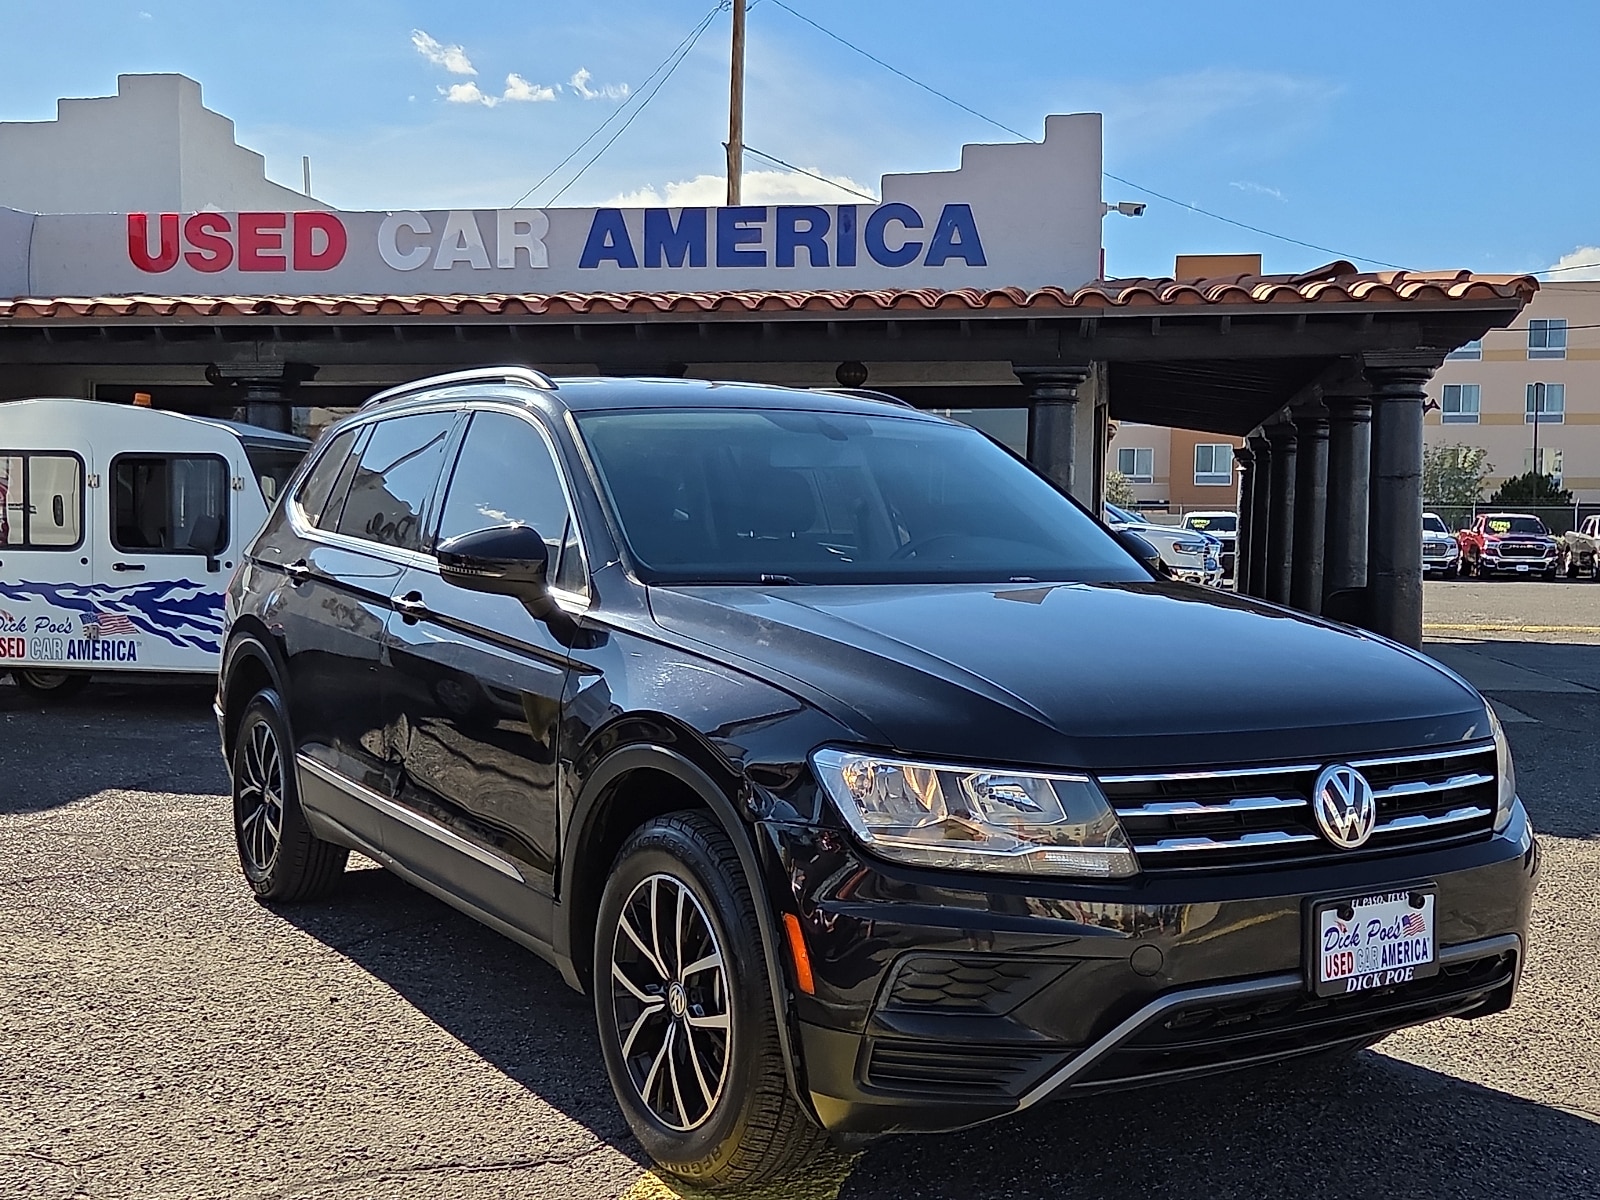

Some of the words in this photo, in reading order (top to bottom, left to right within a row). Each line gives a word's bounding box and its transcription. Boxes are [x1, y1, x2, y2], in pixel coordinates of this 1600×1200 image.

[127, 212, 348, 273] USED
[377, 209, 550, 271] CAR
[579, 202, 988, 268] AMERICA
[34, 616, 74, 634] Poe's
[0, 637, 25, 658] SED
[30, 637, 63, 660] CAR
[66, 639, 137, 661] AMERICA
[1387, 891, 1409, 903] TEXAS
[1324, 922, 1361, 952] Dick
[1366, 915, 1402, 945] Poe's
[1325, 951, 1354, 978] USED
[1356, 946, 1379, 973] CAR
[1381, 937, 1429, 968] AMERICA
[1345, 971, 1382, 993] DICK
[1383, 966, 1415, 986] POE
